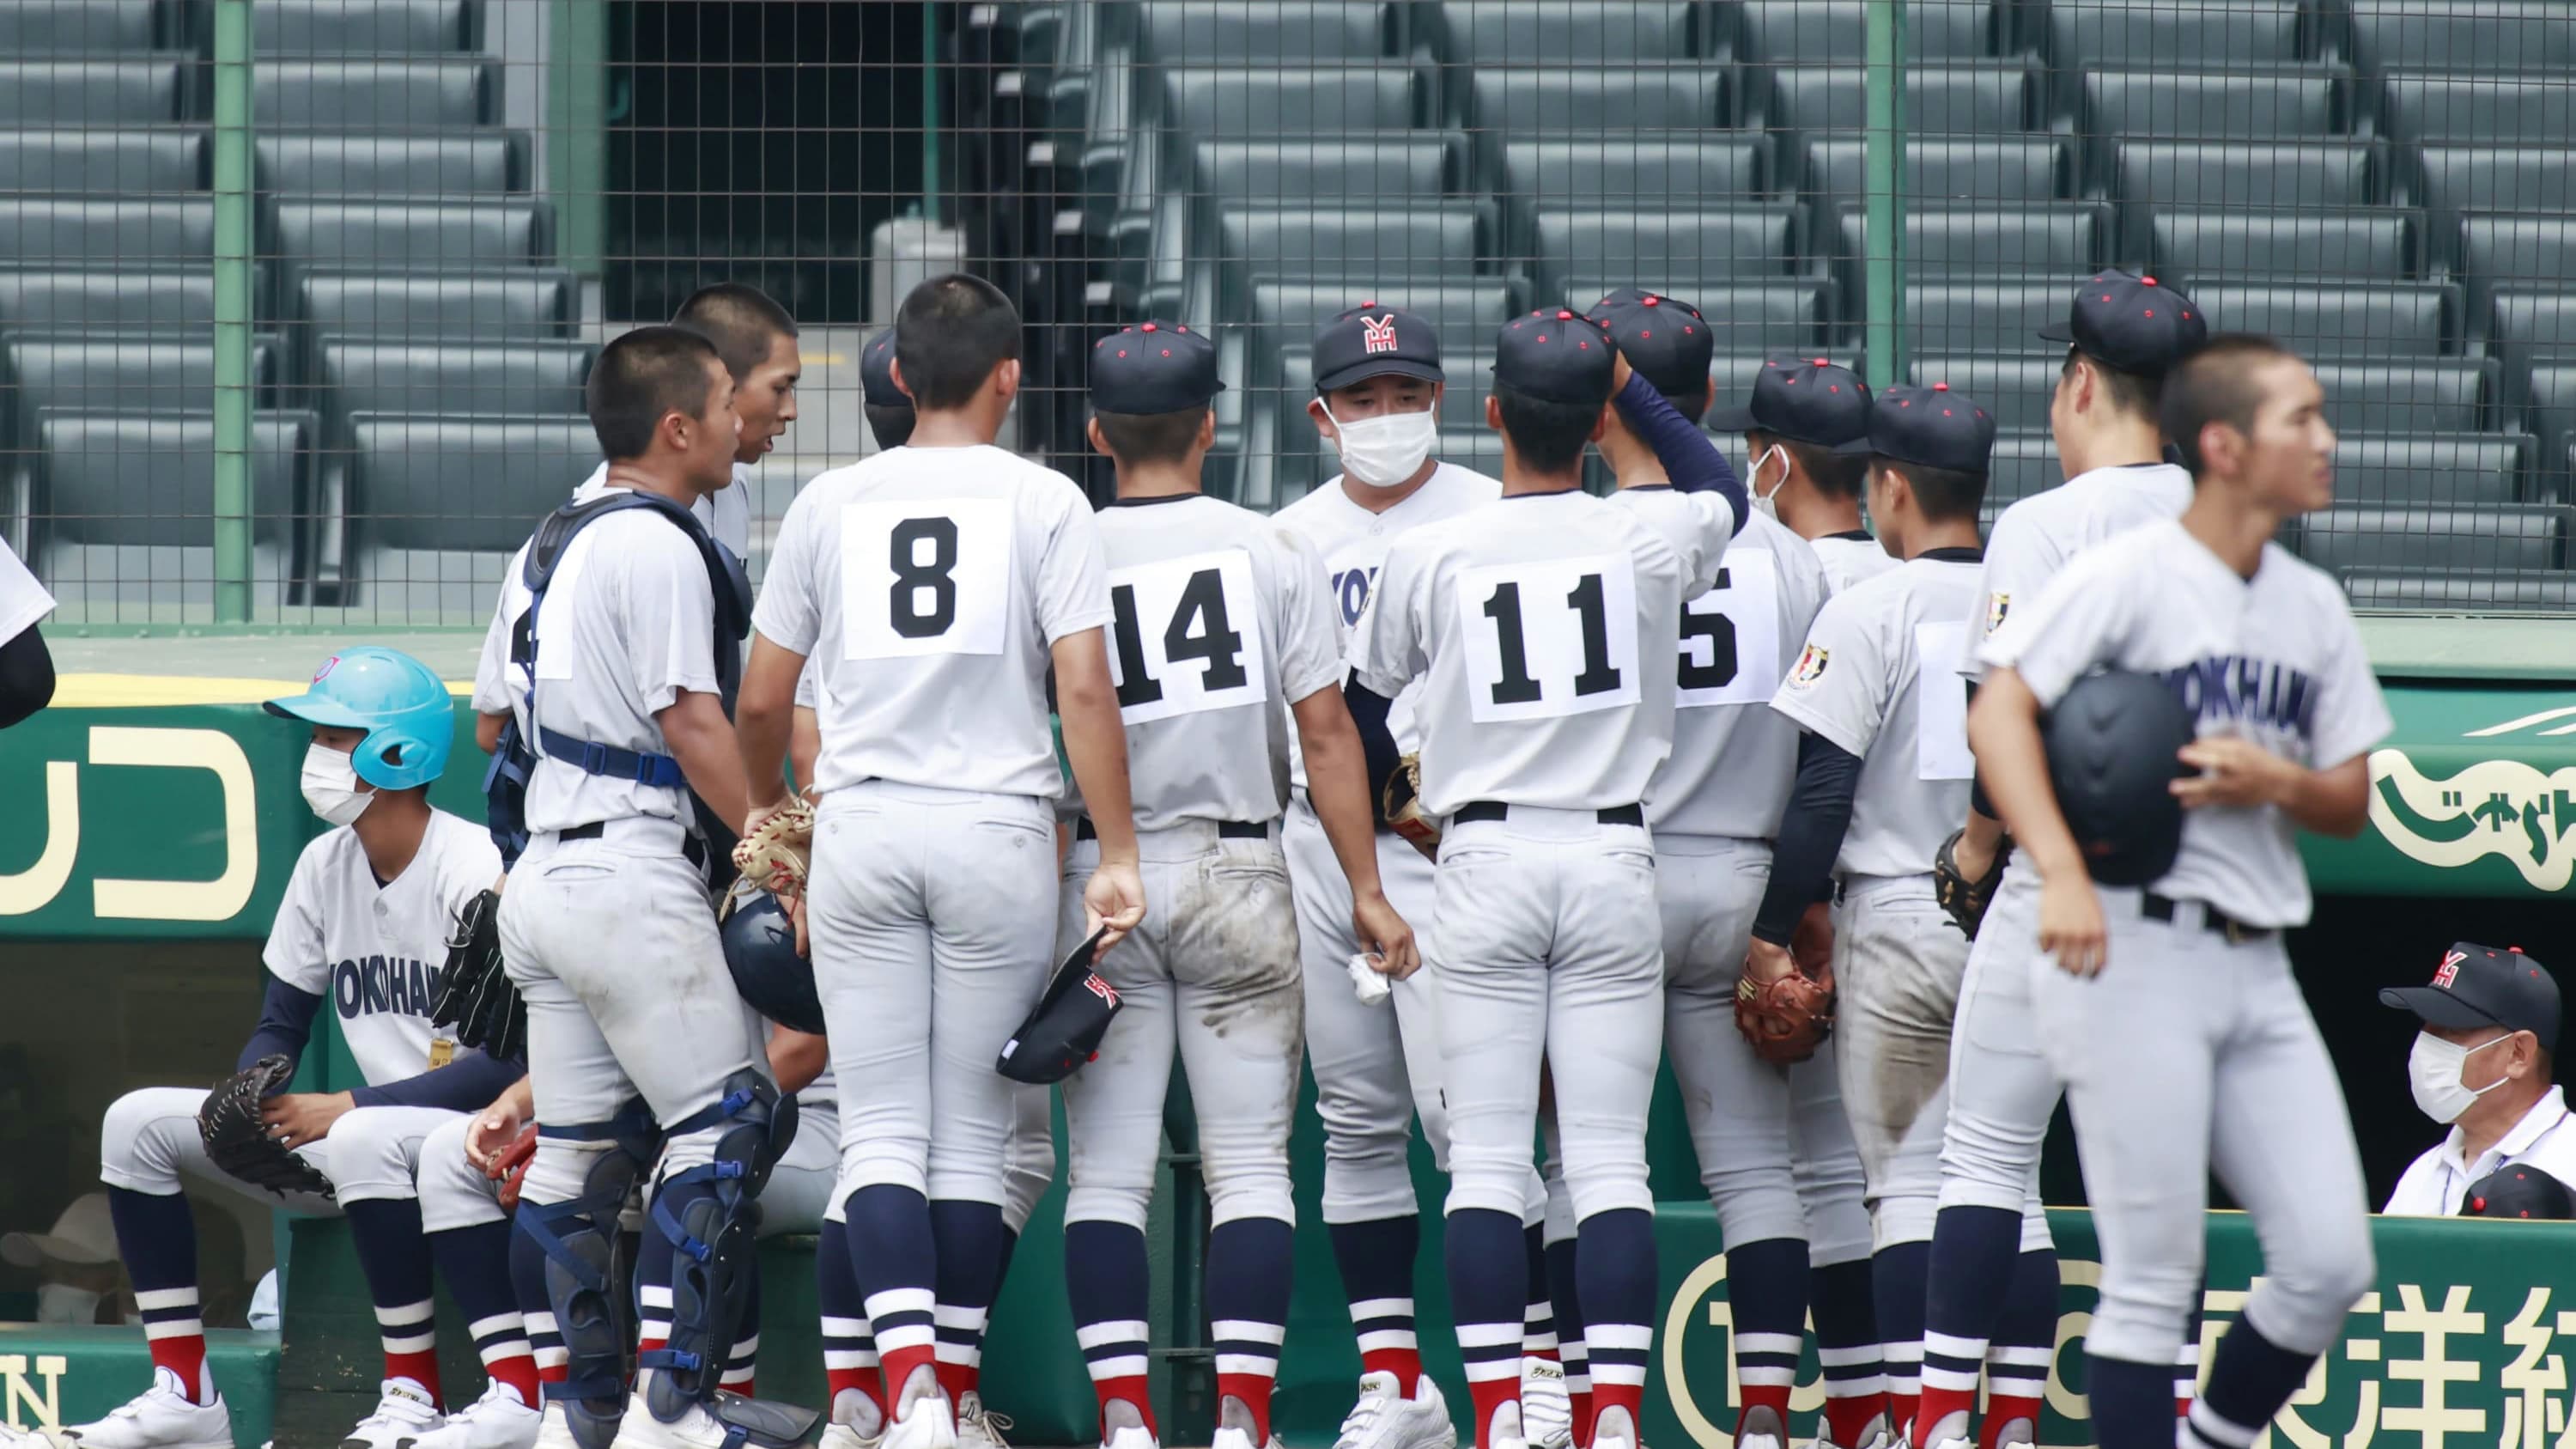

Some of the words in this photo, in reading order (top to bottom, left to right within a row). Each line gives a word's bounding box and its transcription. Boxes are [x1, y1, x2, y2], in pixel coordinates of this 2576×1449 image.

[890, 517, 958, 638] 8
[1112, 568, 1248, 708] 14
[1484, 574, 1621, 704] 11
[1677, 568, 1738, 690] 5
